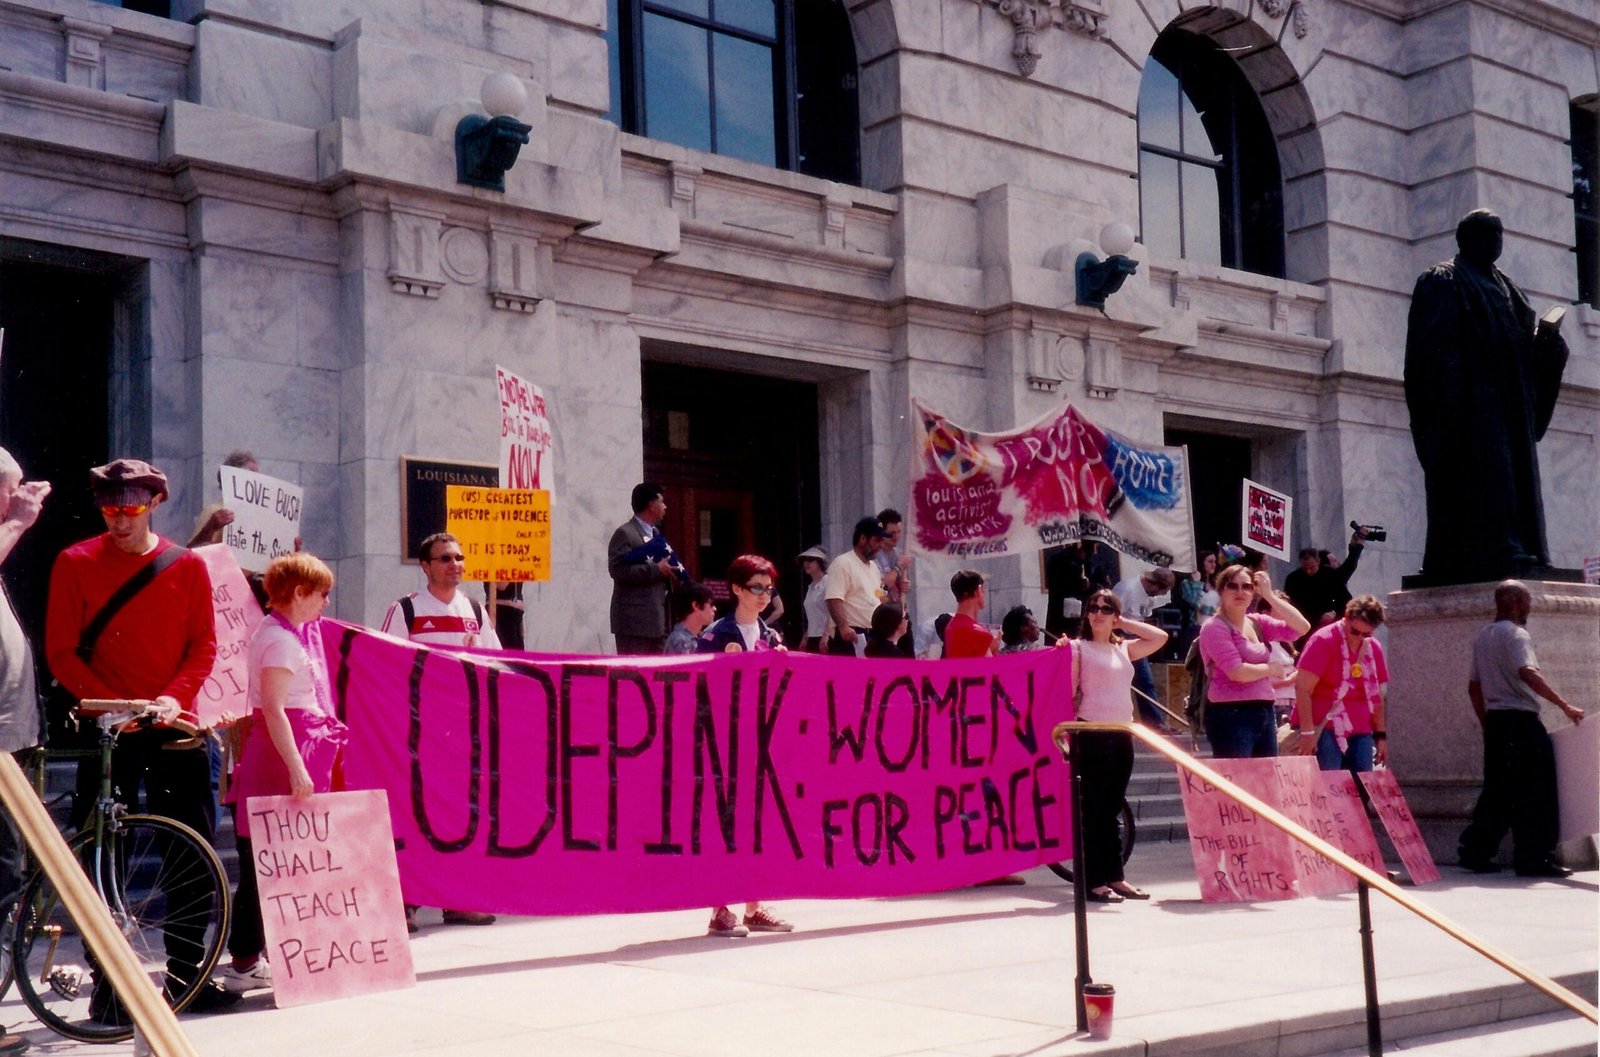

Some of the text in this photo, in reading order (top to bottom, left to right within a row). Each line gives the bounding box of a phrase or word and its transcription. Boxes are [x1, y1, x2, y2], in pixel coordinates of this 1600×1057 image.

[416, 469, 487, 485] LOUISIANA
[508, 443, 542, 489] NOW
[1111, 440, 1169, 494] HOME
[231, 475, 299, 522] LOVE BUSH
[485, 492, 534, 506] GREATEST
[926, 483, 996, 507] louisiana
[448, 507, 490, 521] PURVEYOR
[501, 510, 549, 523] VIOLENCE
[936, 500, 993, 522] activist
[943, 516, 1003, 539] network
[226, 525, 247, 550] Hate
[252, 530, 268, 556] the
[485, 543, 496, 556] IS
[500, 543, 530, 556] TODAY
[495, 569, 536, 582] ORLEANS
[216, 607, 249, 631] THY
[826, 669, 1037, 774] WOMEN
[822, 756, 1060, 870] FOR PEACE
[252, 808, 330, 845] THOU
[1193, 833, 1262, 853] THE BILL
[258, 849, 343, 879] SHALL
[1231, 852, 1248, 870] OF
[1214, 870, 1290, 895] RIGHTS
[267, 887, 360, 926] TEACH
[279, 938, 389, 978] PEACE
